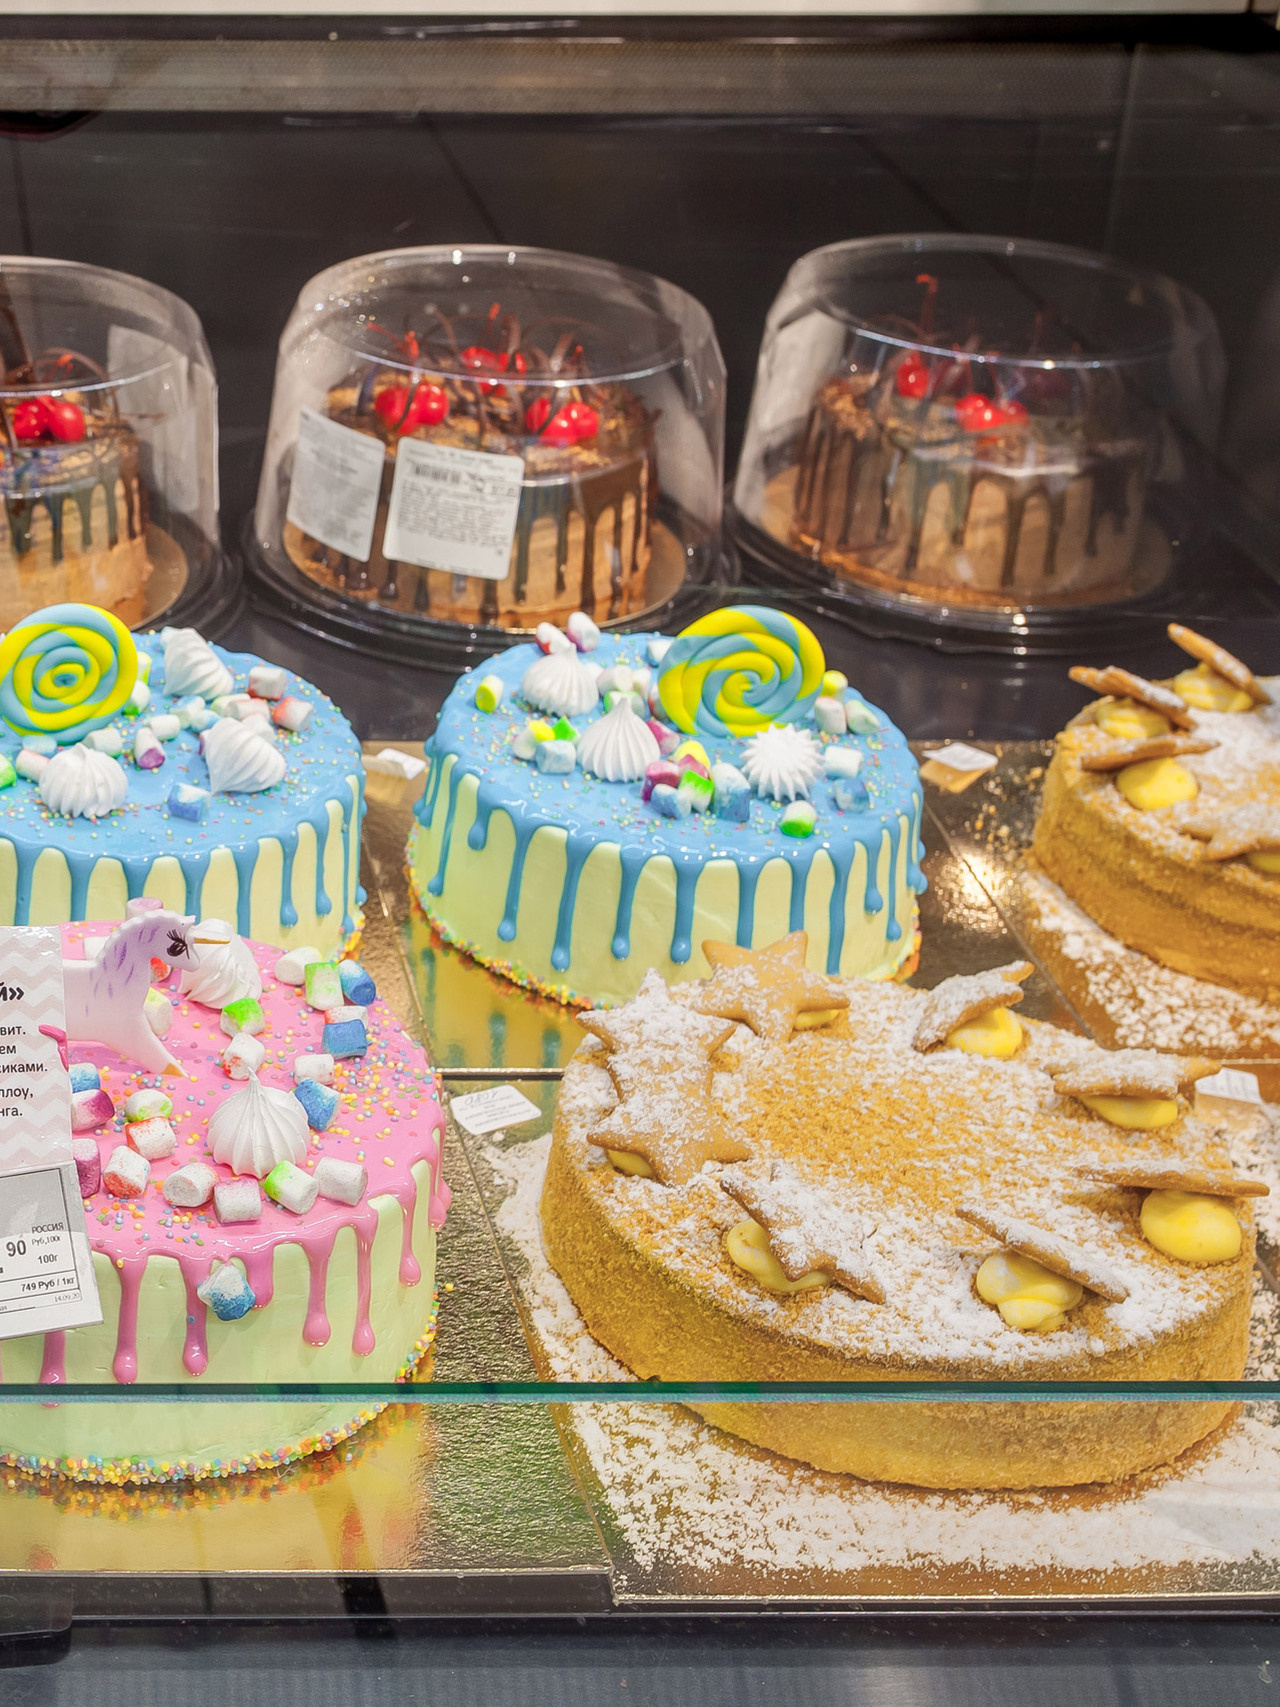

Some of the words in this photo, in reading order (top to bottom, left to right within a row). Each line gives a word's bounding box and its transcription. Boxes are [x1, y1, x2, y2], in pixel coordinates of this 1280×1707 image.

[31, 1222, 64, 1234] РОССИЯ
[6, 1240, 27, 1257] 90
[37, 1254, 59, 1264] 100г
[21, 1283, 37, 1292] 749
[38, 1279, 55, 1290] Руб
[62, 1277, 75, 1285] 1кг
